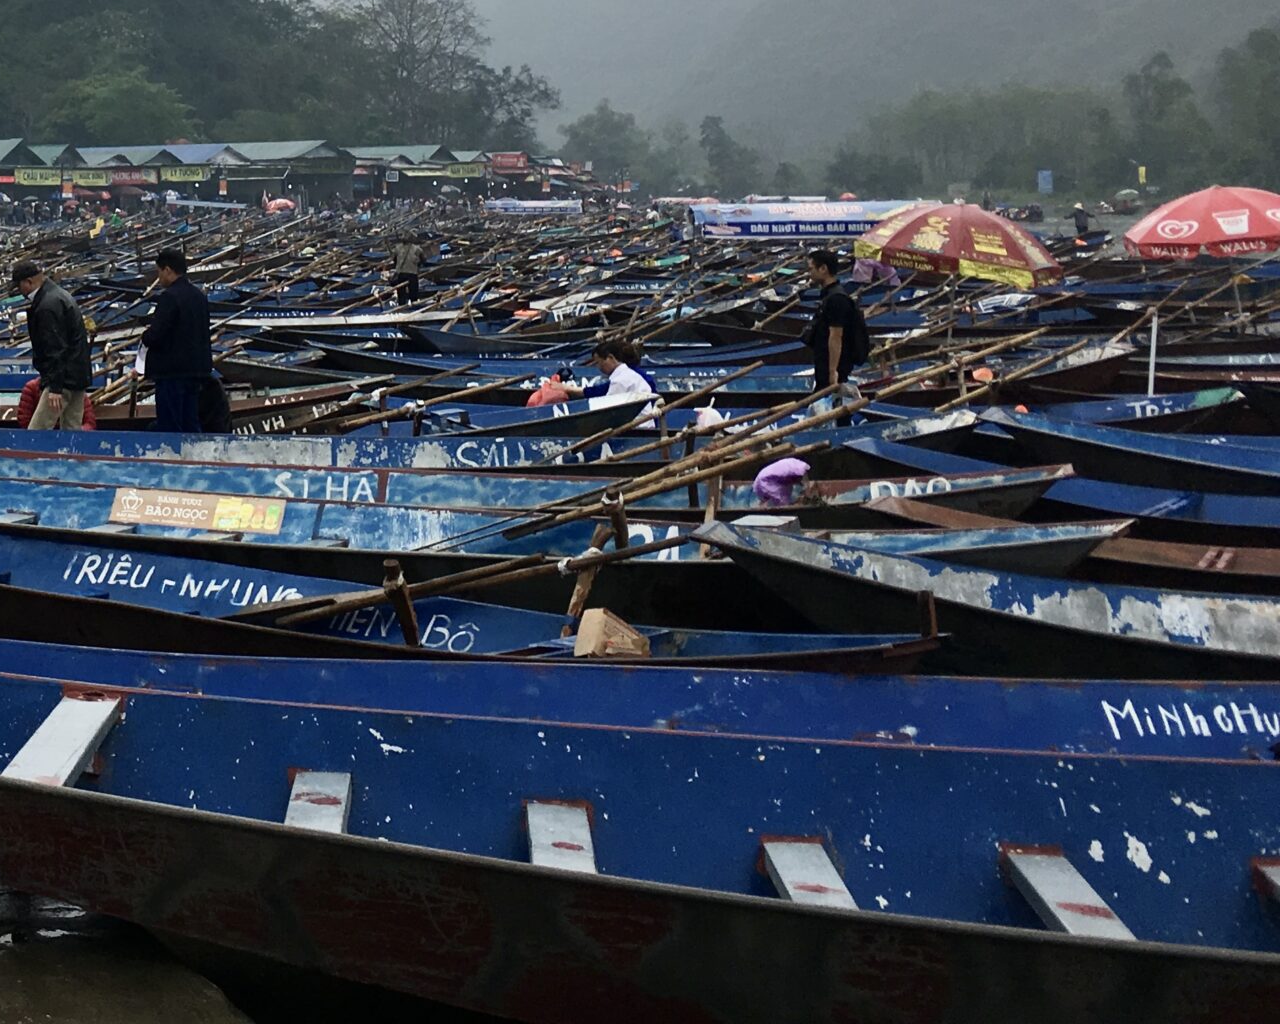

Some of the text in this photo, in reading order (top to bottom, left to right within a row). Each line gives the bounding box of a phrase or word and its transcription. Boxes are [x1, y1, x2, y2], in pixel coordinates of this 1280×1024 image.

[1151, 246, 1190, 257] WALL'S
[1220, 240, 1268, 253] WALL'S
[144, 502, 208, 521] BẢO NGỌC
